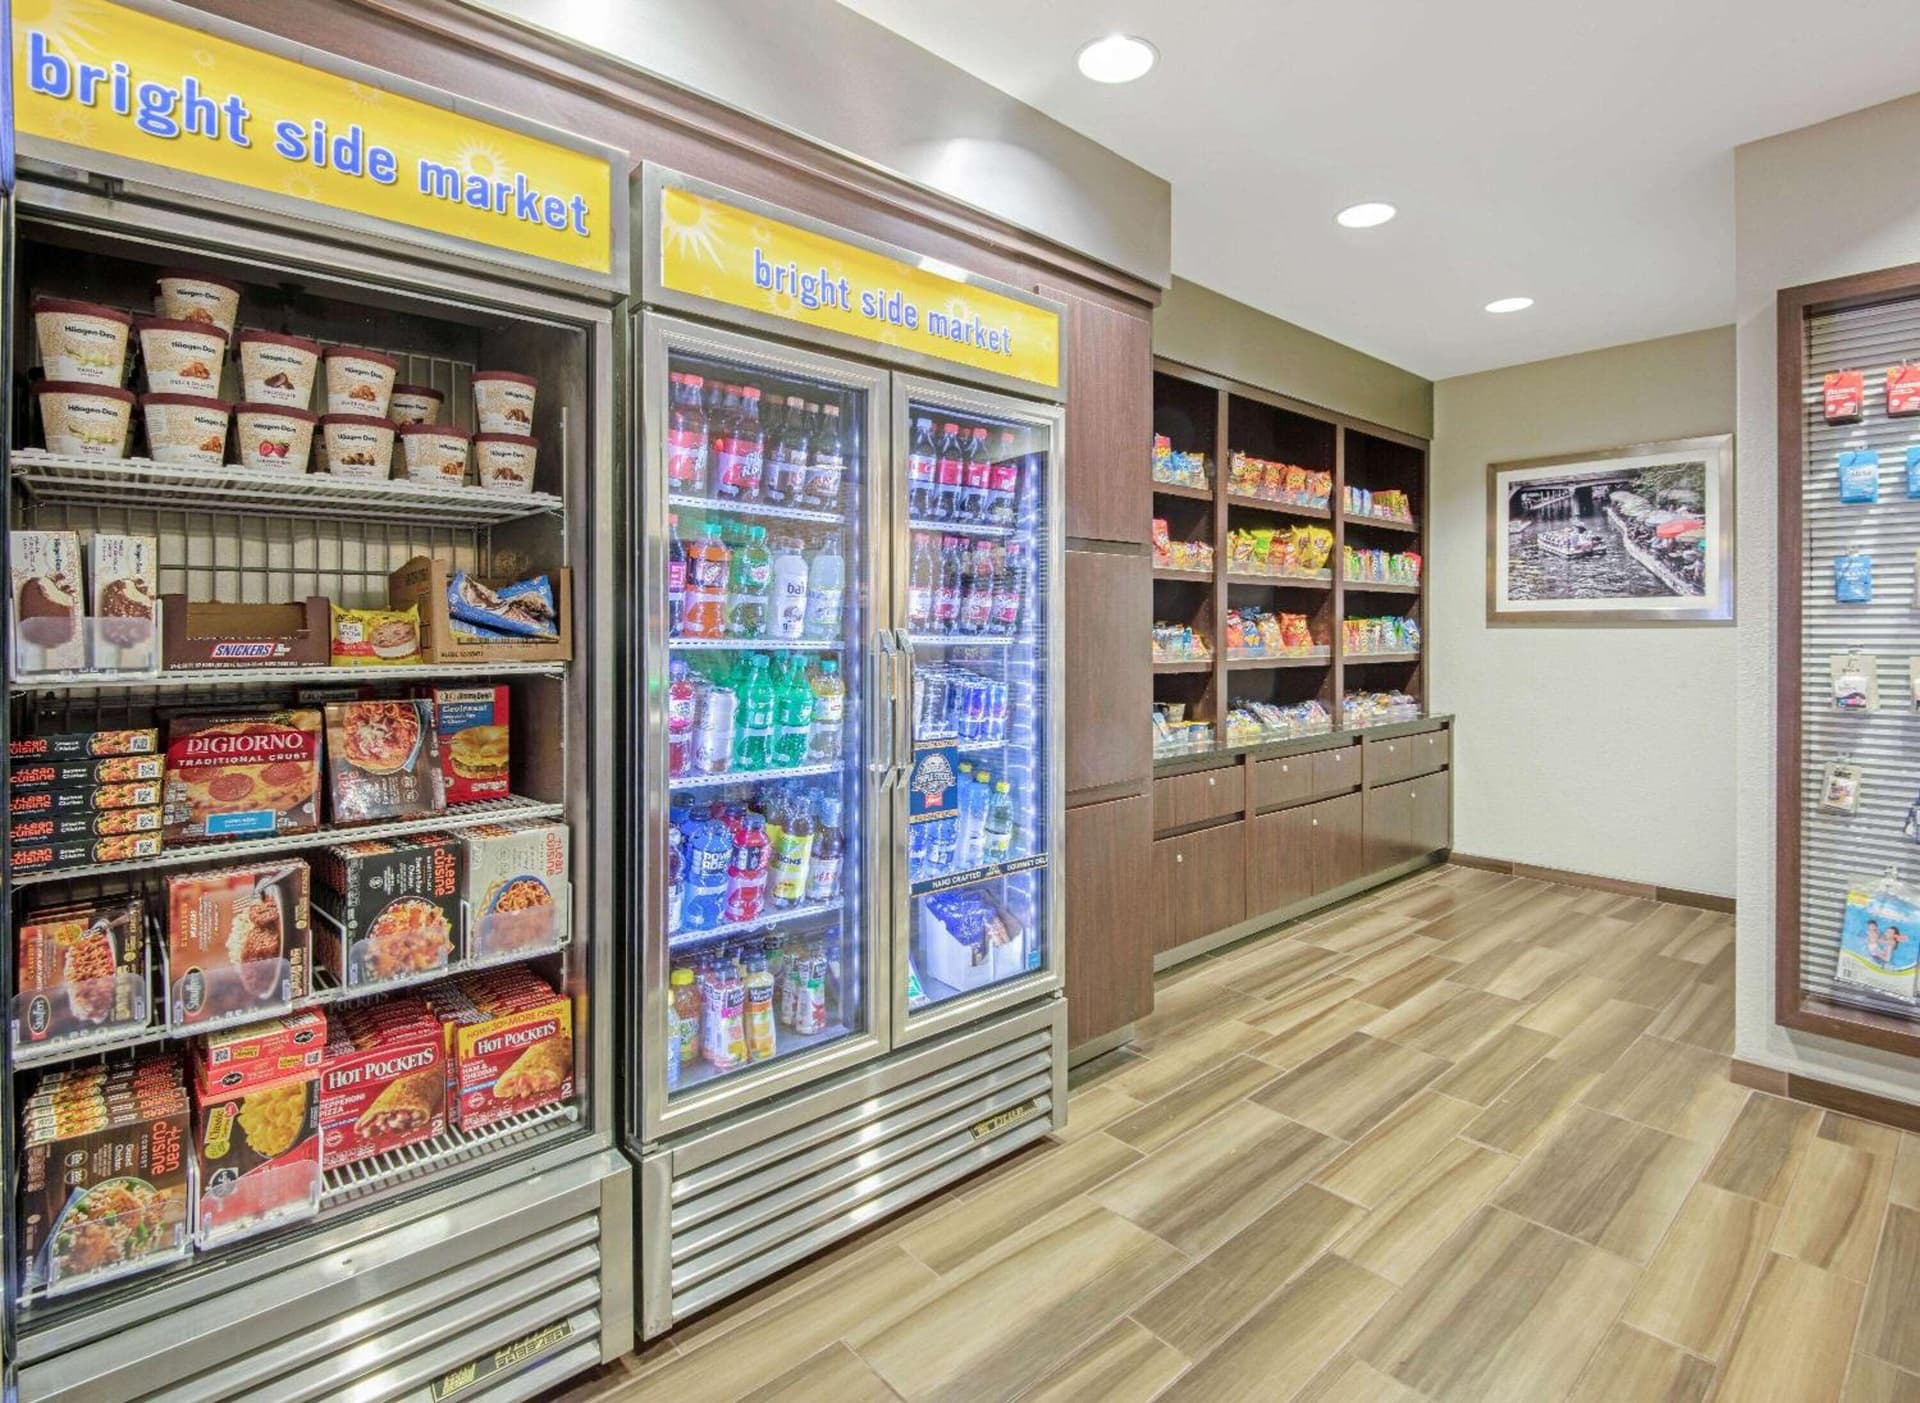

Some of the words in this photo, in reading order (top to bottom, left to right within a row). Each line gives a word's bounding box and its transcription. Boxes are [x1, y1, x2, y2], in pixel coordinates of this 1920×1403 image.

[28, 32, 252, 148] bright
[274, 120, 399, 184] side
[417, 156, 592, 237] market
[753, 248, 850, 311] bright
[862, 287, 918, 330] side
[927, 309, 1013, 356] market
[215, 644, 271, 656] SNICKERS
[178, 756, 265, 767] TRADITIONAL
[268, 752, 308, 761] CRUST
[434, 848, 446, 898] cuisine
[444, 864, 456, 895] Lean
[477, 1037, 502, 1055] HOT
[504, 1020, 556, 1047] POCKETS
[328, 1068, 361, 1090] HOT
[364, 1047, 434, 1081] POCKETS
[561, 1082, 572, 1095] 2
[432, 1119, 443, 1131] 2
[151, 1121, 167, 1176] cuisine
[165, 1137, 181, 1173] Lean
[495, 1329, 564, 1369] FREEZER
